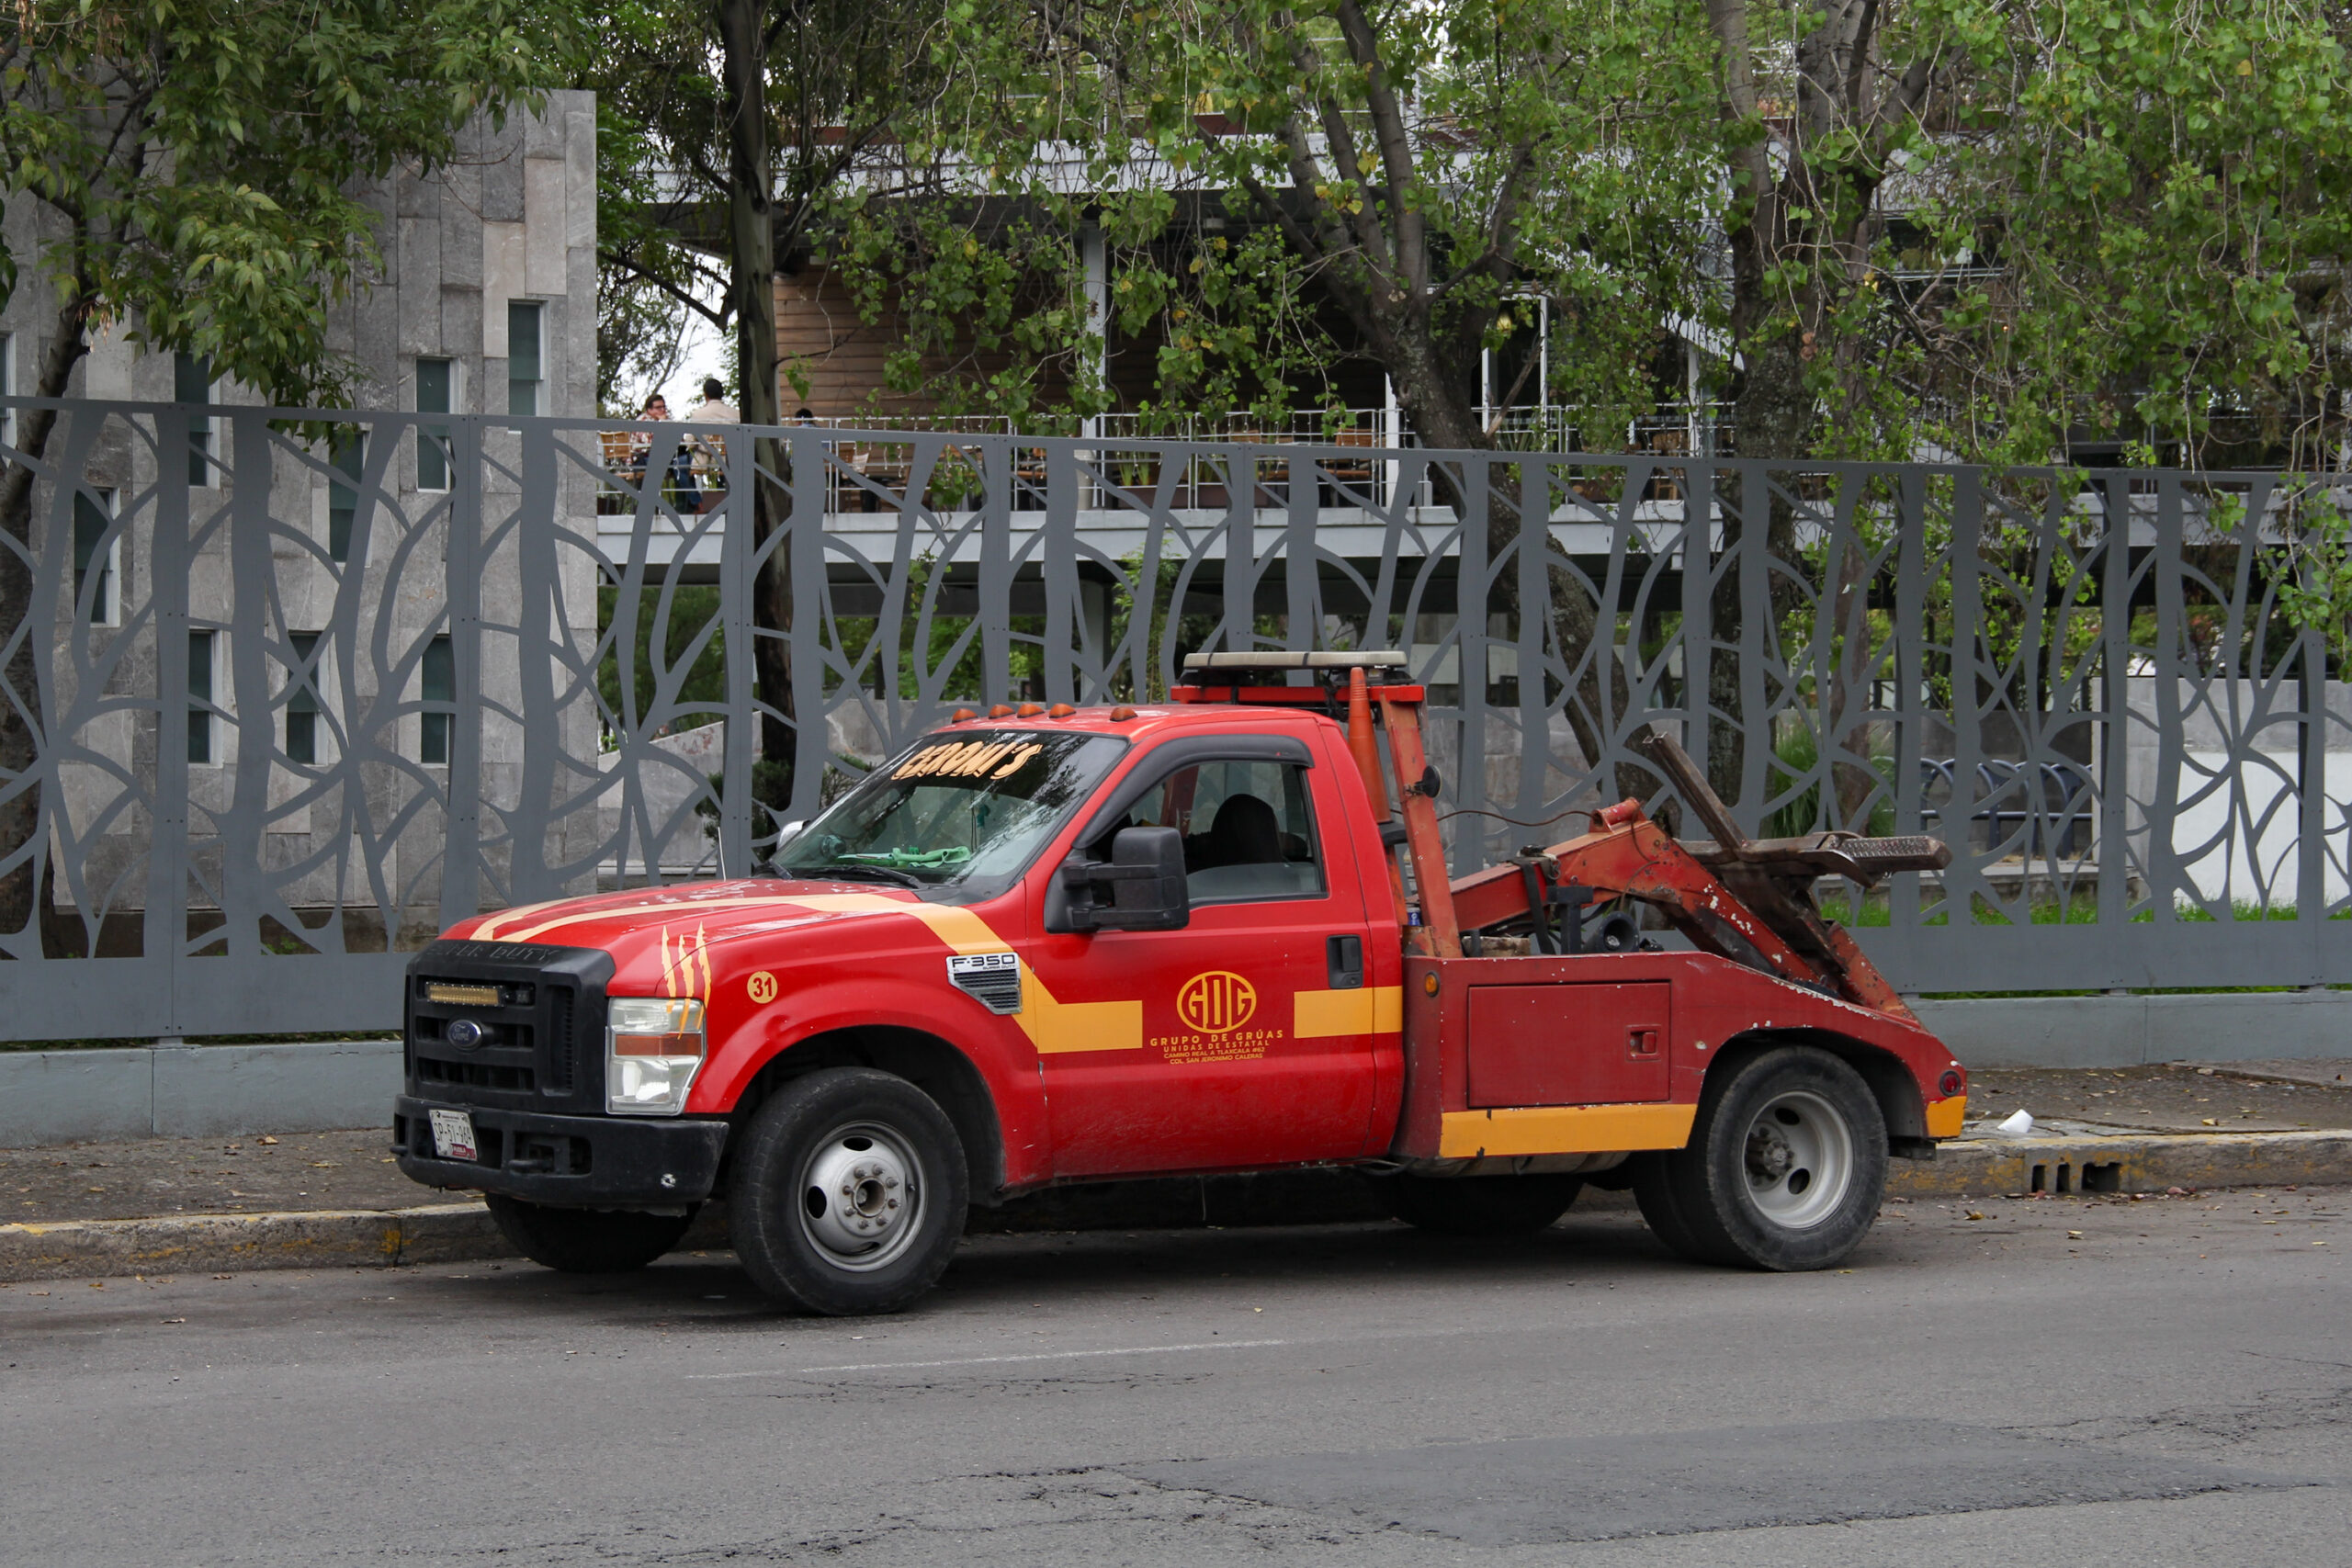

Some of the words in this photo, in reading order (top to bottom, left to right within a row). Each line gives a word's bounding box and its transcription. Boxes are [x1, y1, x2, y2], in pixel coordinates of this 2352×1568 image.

[490, 945, 560, 961] DUTY
[753, 976, 772, 998] 31
[1150, 1035, 1200, 1046] GRUPO
[1211, 1032, 1227, 1043] DE
[1236, 1029, 1283, 1042] GRÚAS
[1163, 1043, 1203, 1053] UNIDAS
[1208, 1042, 1220, 1050] DE
[1226, 1040, 1270, 1048] ESTATAL
